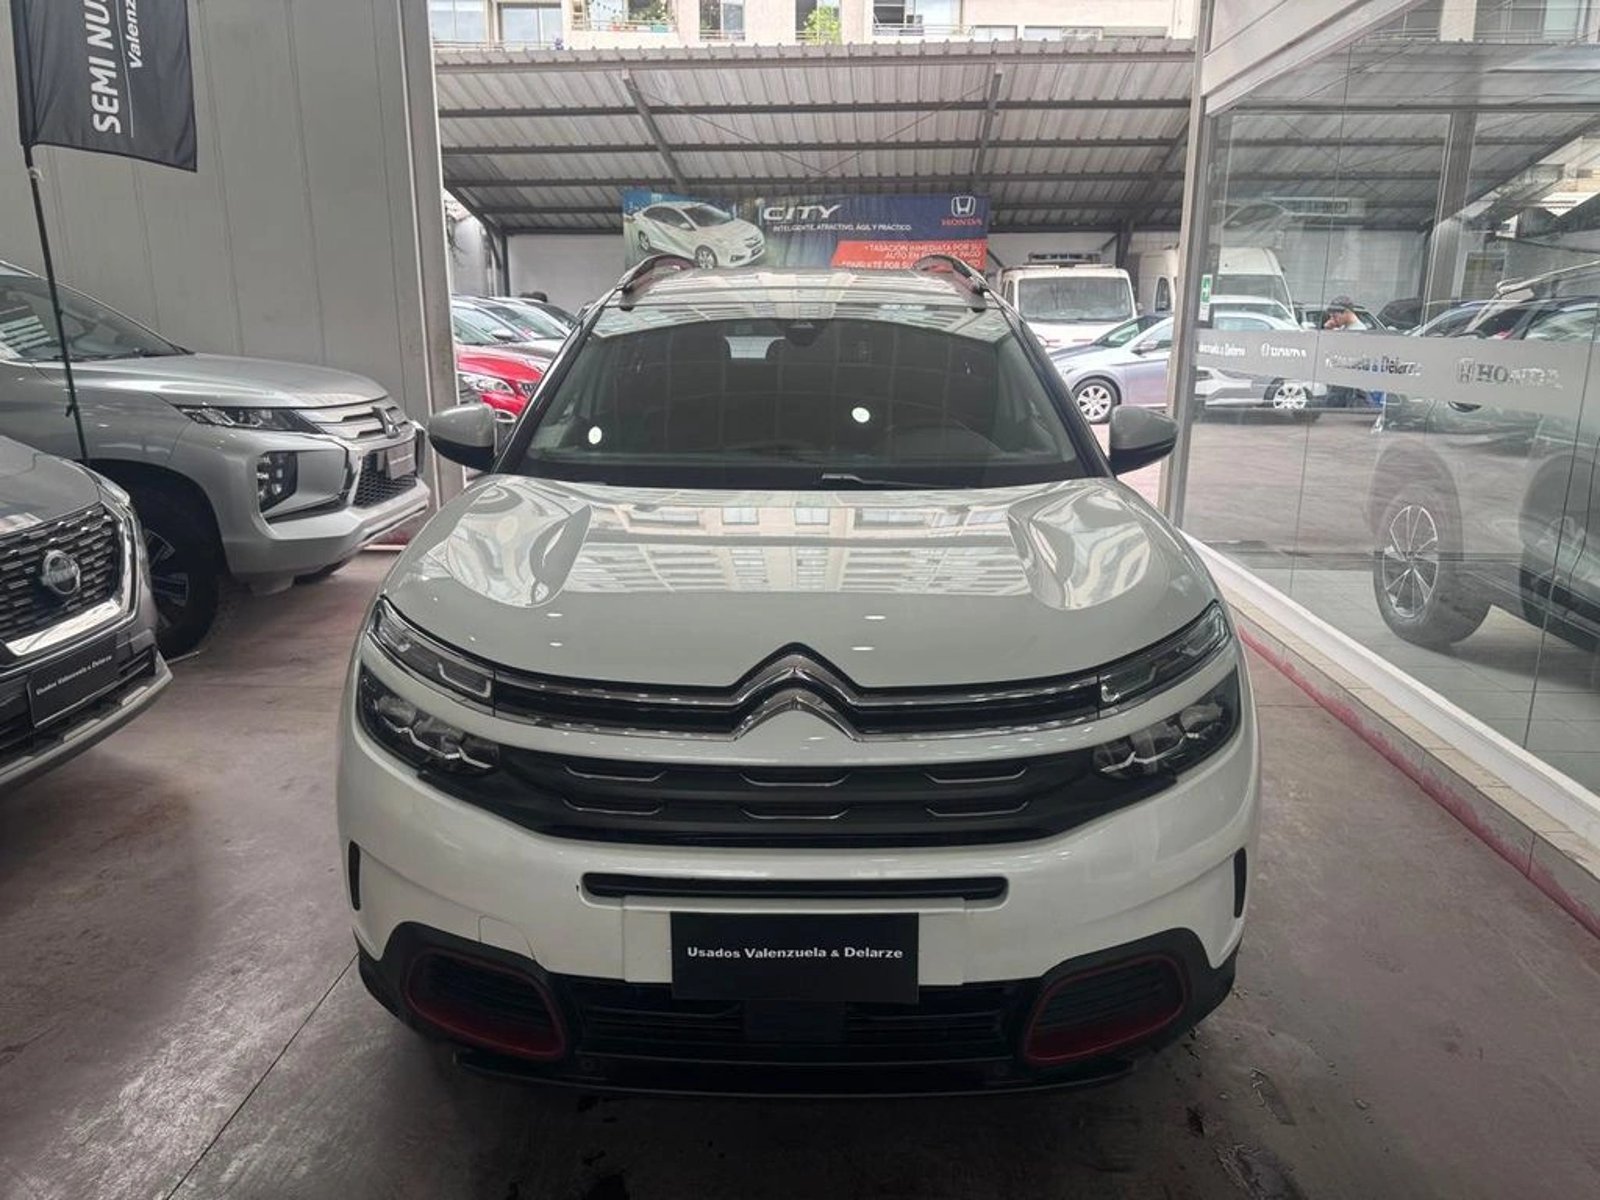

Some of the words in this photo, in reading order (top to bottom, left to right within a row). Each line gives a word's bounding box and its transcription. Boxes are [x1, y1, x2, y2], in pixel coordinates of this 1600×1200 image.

[84, 0, 114, 50] NU
[89, 56, 121, 134] SEMI
[763, 204, 842, 220] CITY
[941, 218, 983, 227] HONDA
[953, 243, 969, 251] POR
[885, 251, 906, 259] AUTO
[687, 946, 741, 958] Usados
[744, 947, 828, 959] Valenzuela
[830, 948, 840, 958] &
[844, 946, 904, 959] Delarze
